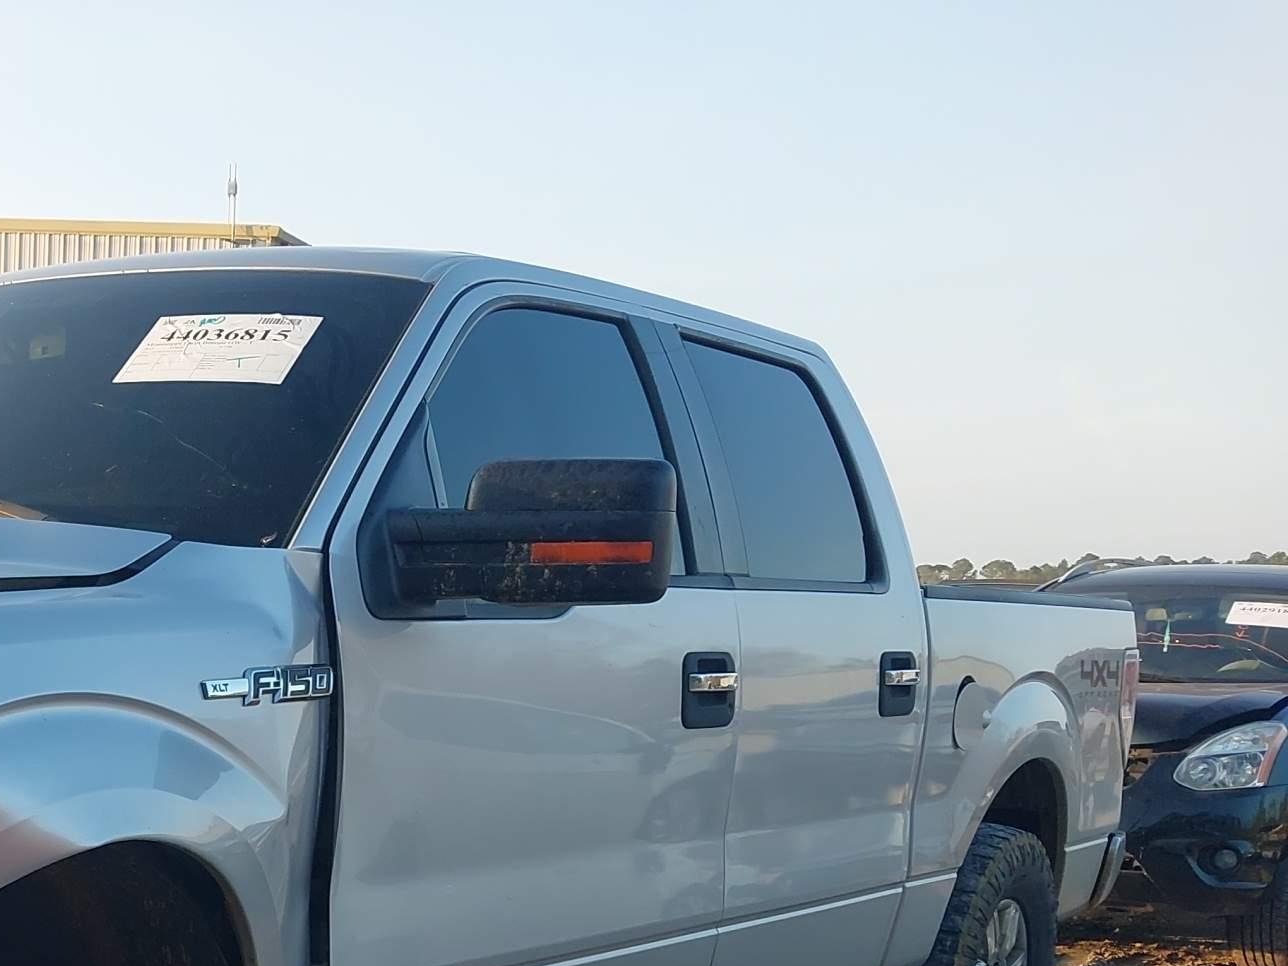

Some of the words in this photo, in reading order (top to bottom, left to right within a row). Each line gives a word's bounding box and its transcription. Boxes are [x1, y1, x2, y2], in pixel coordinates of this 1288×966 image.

[160, 327, 292, 341] 44036815
[211, 683, 229, 692] XLT
[245, 666, 334, 706] F-150
